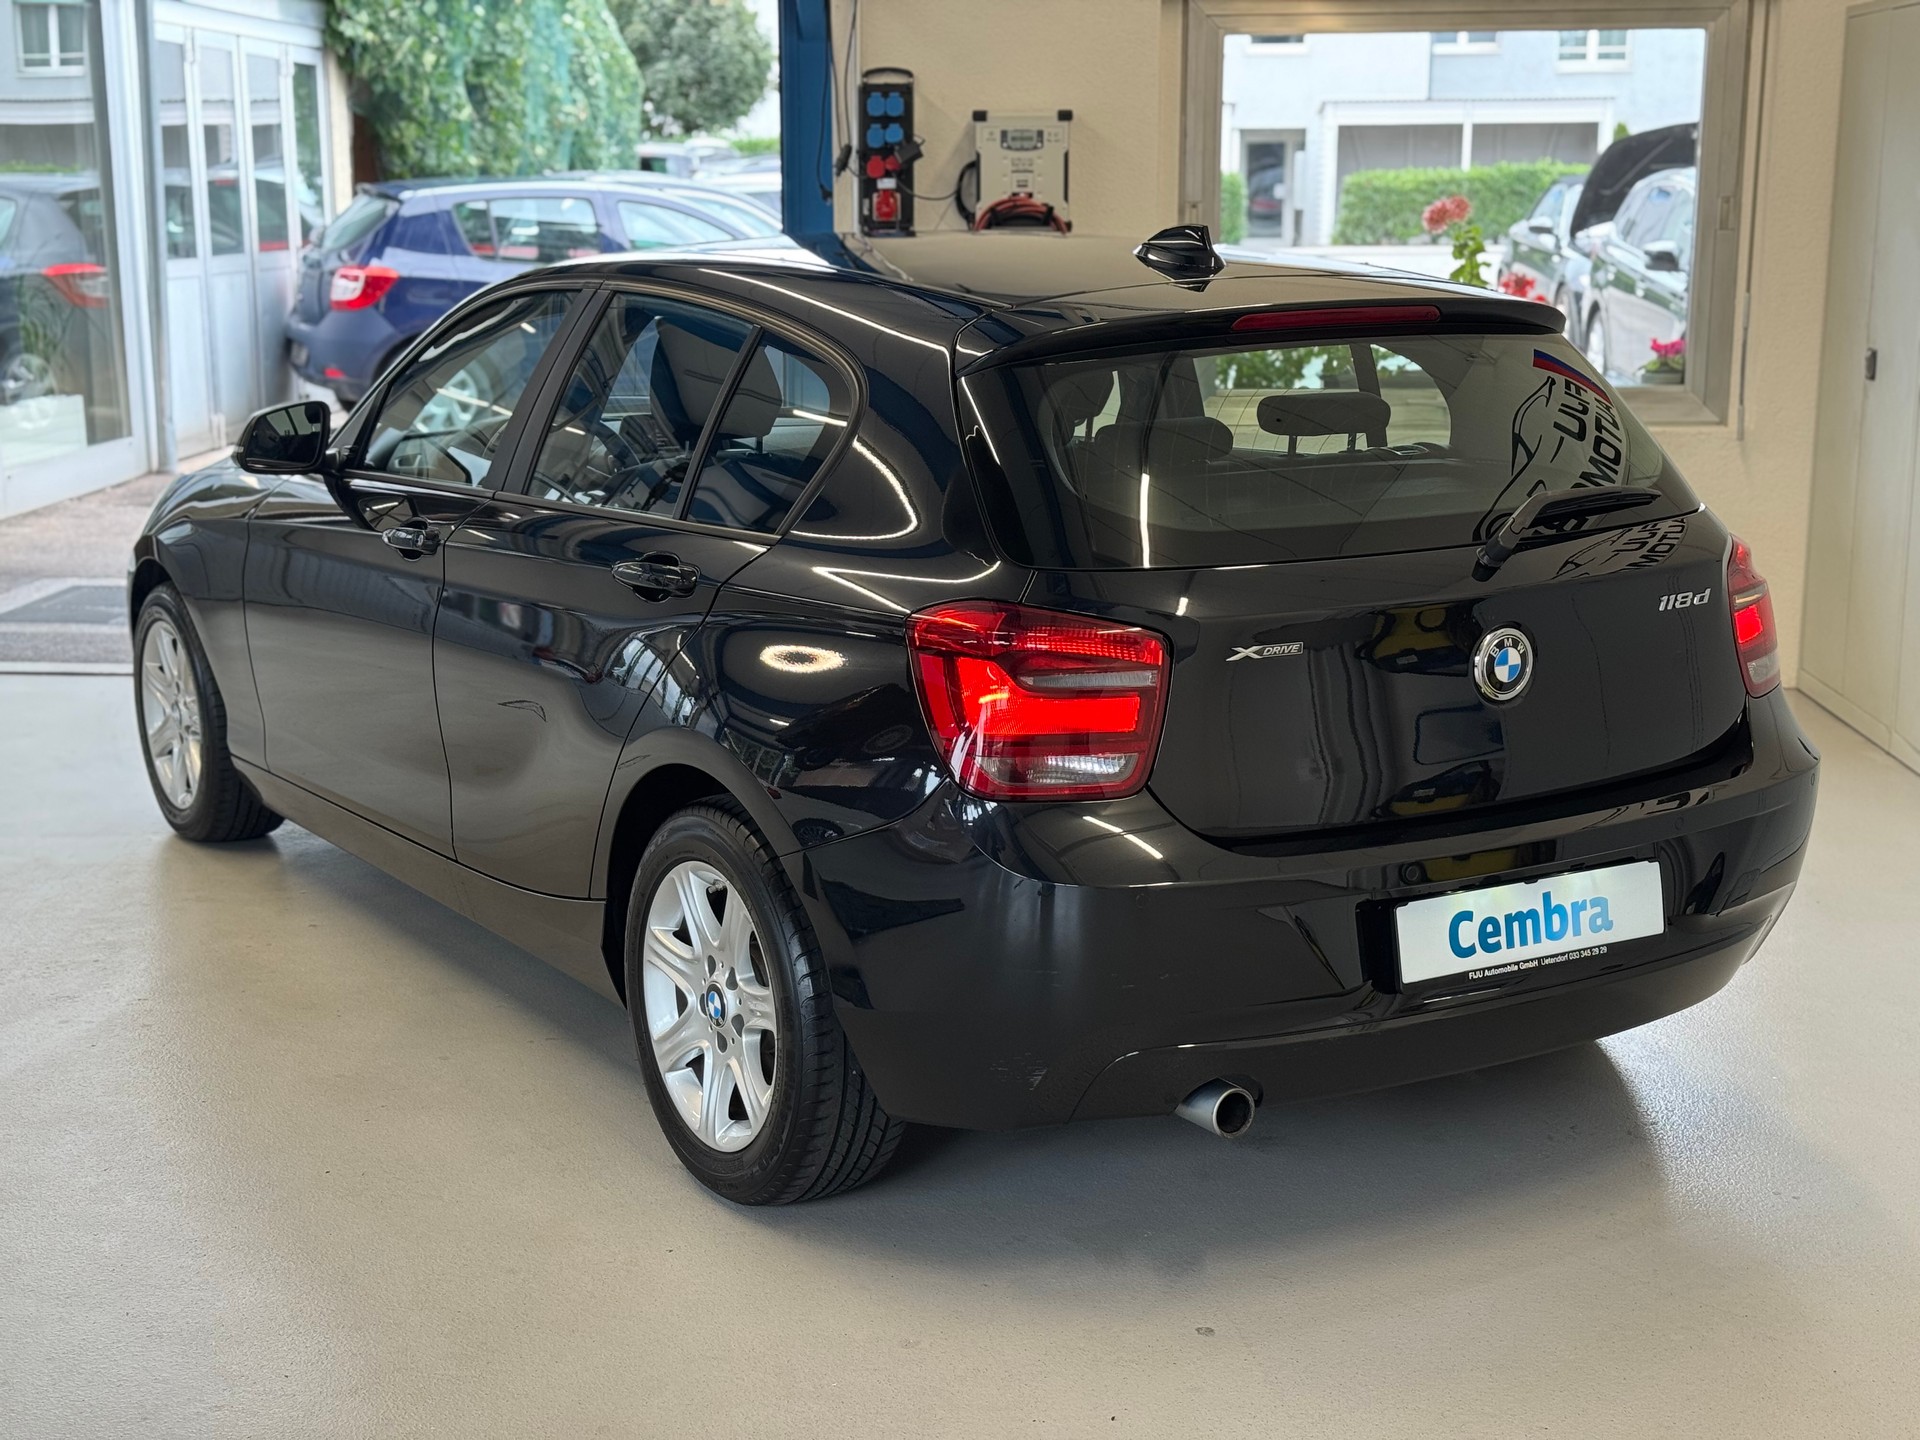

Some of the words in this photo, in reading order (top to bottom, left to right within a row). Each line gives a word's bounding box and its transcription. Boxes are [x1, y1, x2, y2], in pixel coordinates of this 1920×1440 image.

[1658, 587, 1712, 612] 118d
[1490, 637, 1526, 658] BMW
[1448, 890, 1614, 959] Cembra
[1468, 970, 1483, 980] FIJU
[1484, 964, 1519, 977] Automobile
[1519, 959, 1539, 970] GmbH
[1540, 953, 1569, 966] Uetendorf
[1569, 951, 1580, 961] 033
[1580, 949, 1592, 958] 345
[1592, 947, 1600, 955] 29
[1600, 945, 1608, 954] 29
